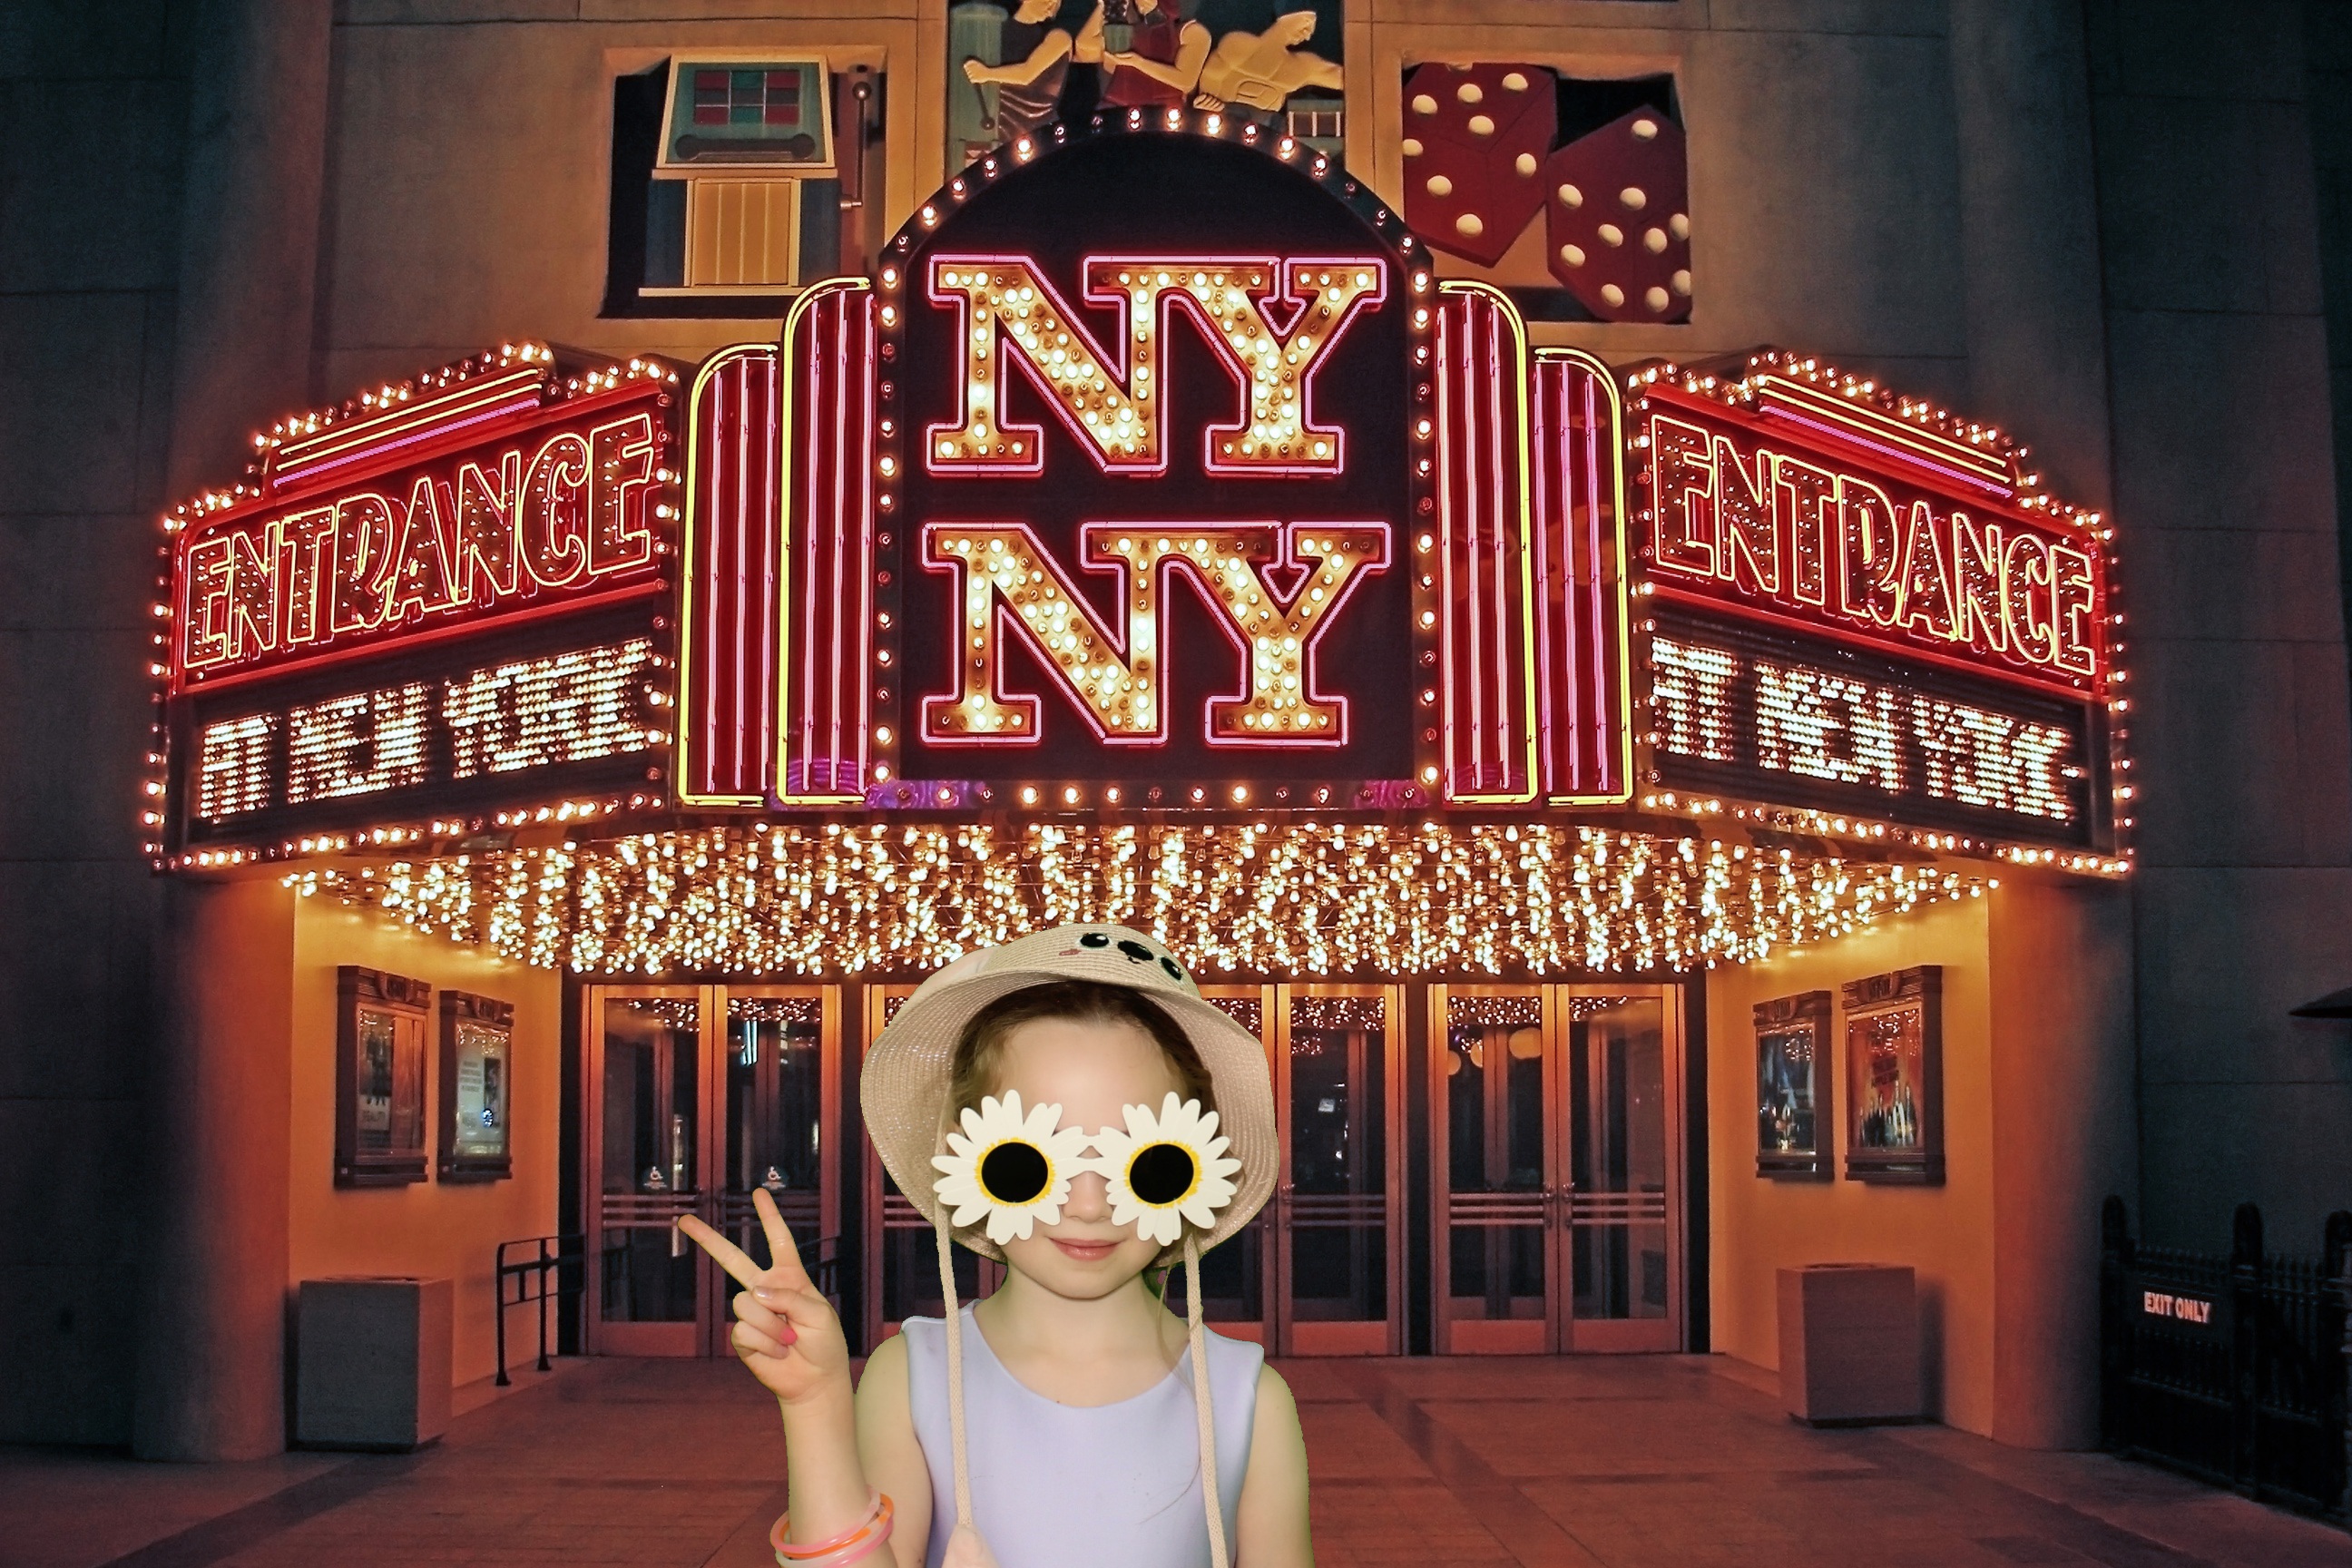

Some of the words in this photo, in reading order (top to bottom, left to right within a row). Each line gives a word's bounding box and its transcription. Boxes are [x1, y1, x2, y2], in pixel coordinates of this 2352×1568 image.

[926, 254, 1387, 475] NY
[183, 412, 652, 670] ENTRANCE
[920, 522, 1392, 748] NY
[1650, 414, 2098, 677] ENTRANCE
[2143, 1291, 2174, 1316] EXIT
[2175, 1297, 2212, 1324] ONLY
